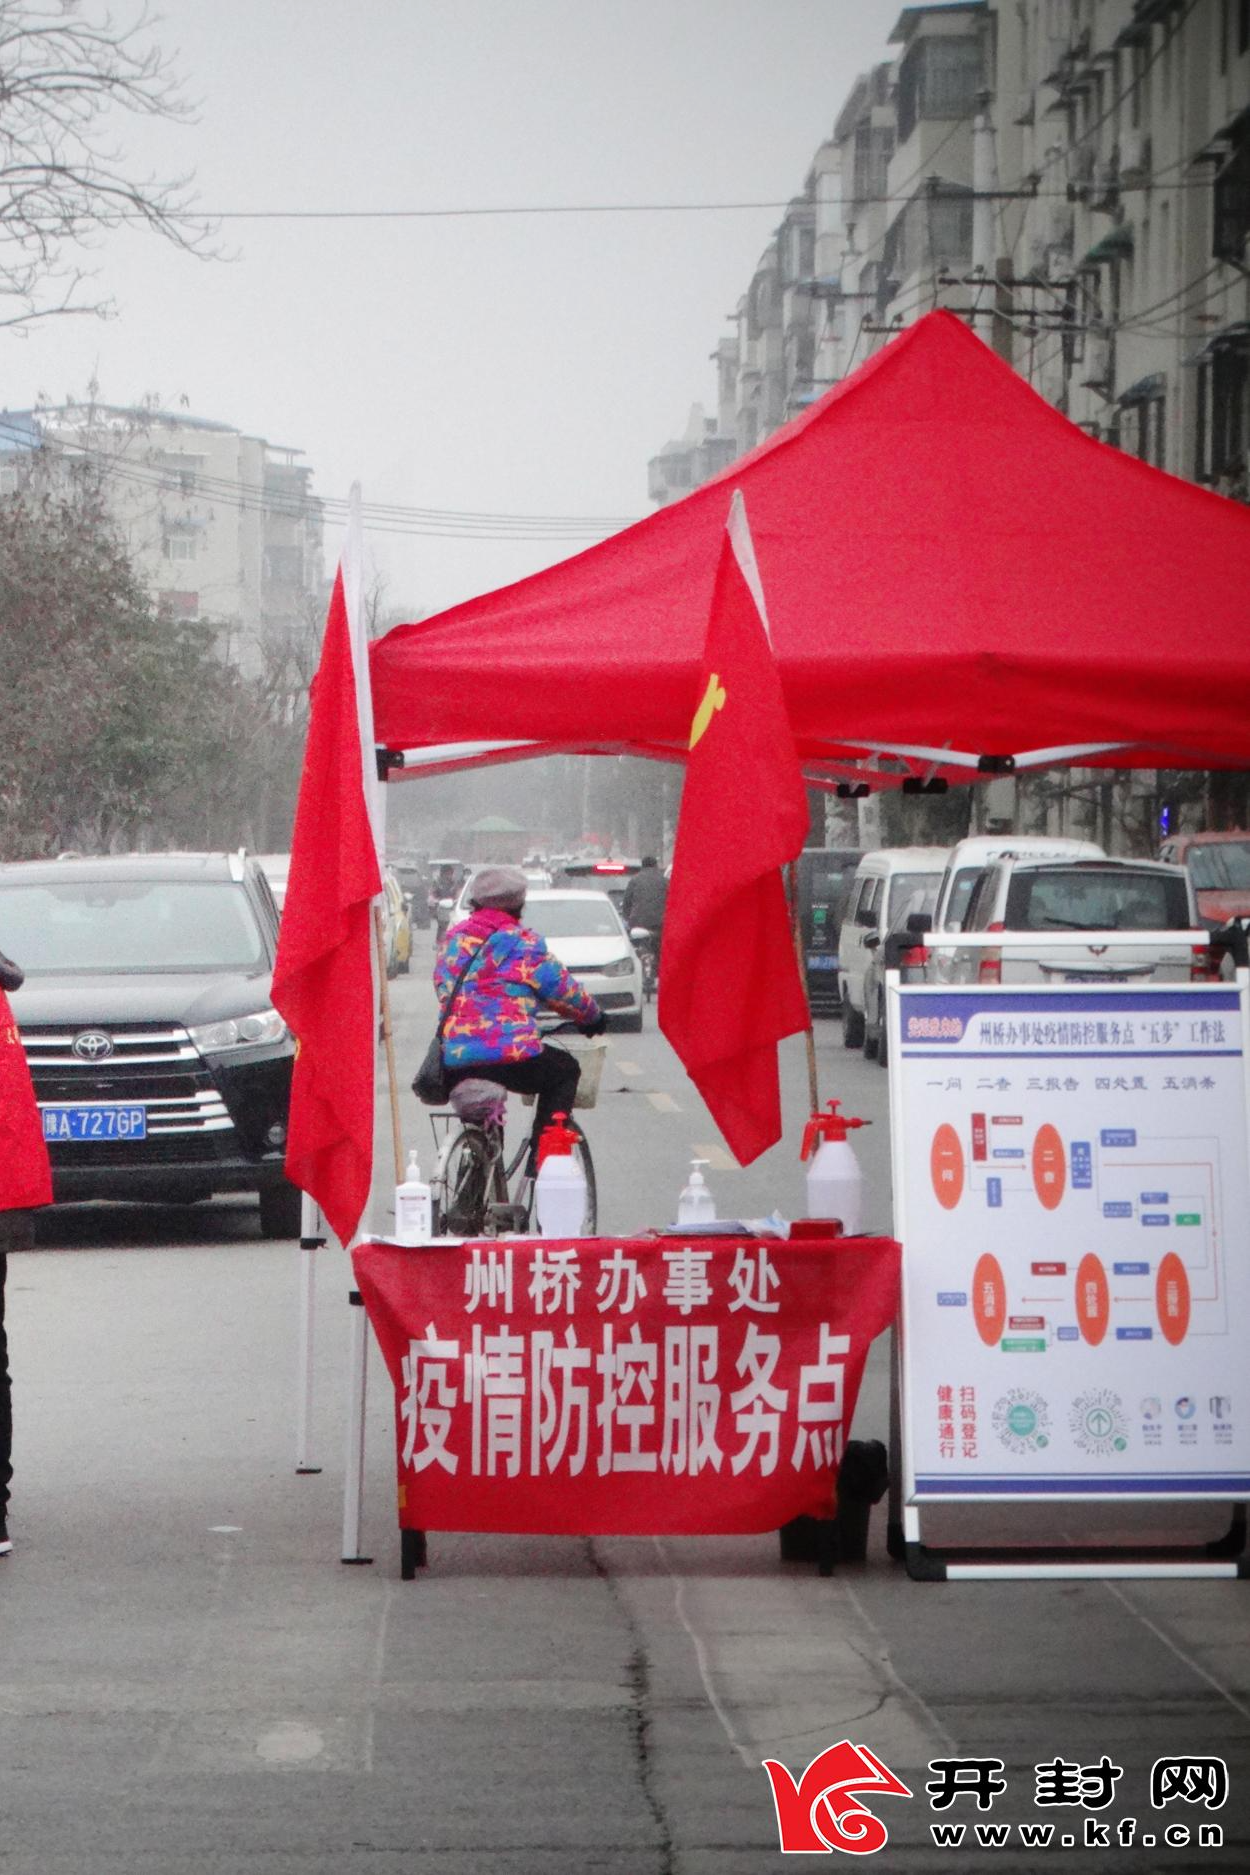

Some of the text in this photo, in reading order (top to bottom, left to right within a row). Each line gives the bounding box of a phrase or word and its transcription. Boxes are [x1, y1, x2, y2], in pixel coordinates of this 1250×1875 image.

[926, 1076, 962, 1091] 一问
[976, 1076, 1012, 1091] 二查
[1026, 1076, 1080, 1092] 三报告
[1095, 1076, 1149, 1092] 四处置
[463, 1247, 782, 1315] 州桥办事处
[400, 1320, 851, 1477] 疫情防控服务点
[936, 1384, 955, 1459] 健康通行
[959, 1385, 978, 1459] 扫码登记
